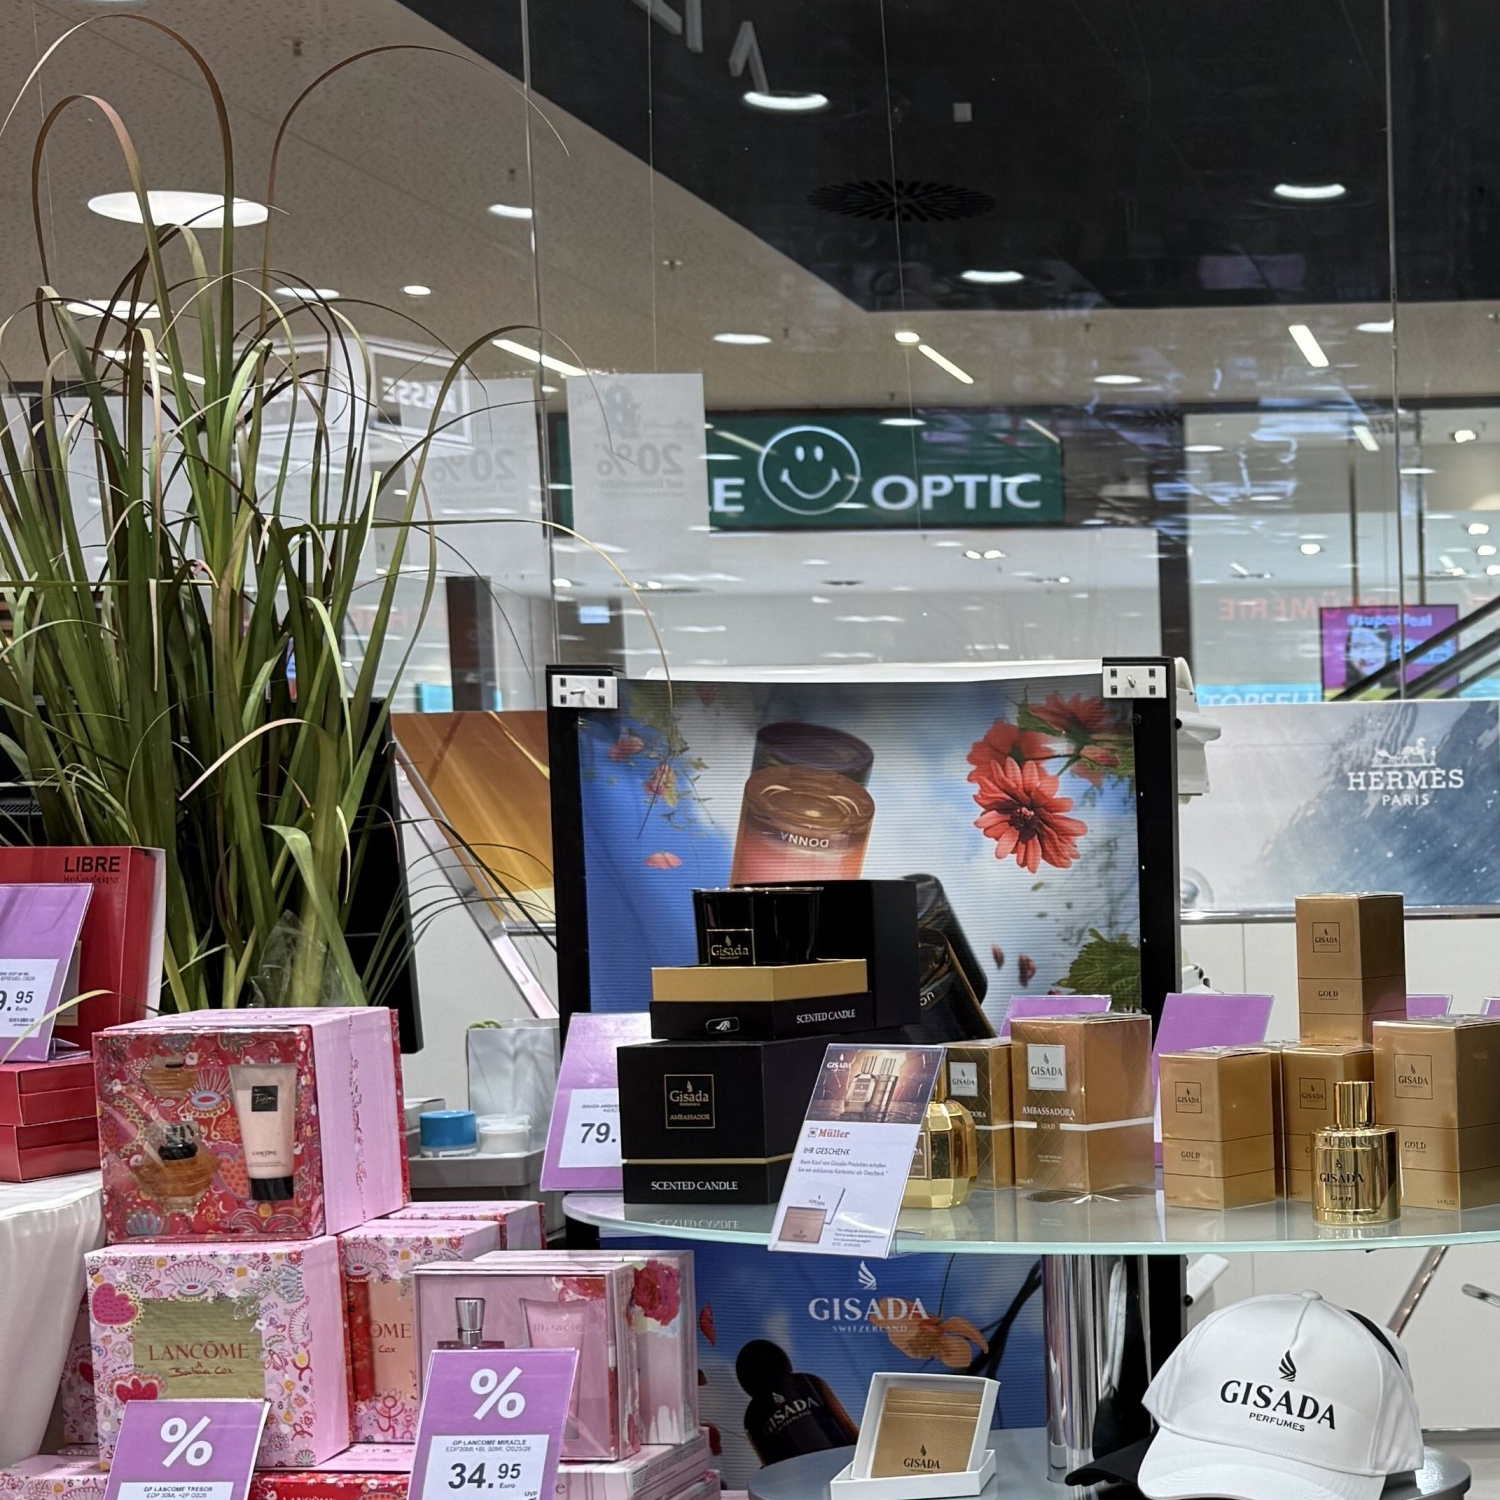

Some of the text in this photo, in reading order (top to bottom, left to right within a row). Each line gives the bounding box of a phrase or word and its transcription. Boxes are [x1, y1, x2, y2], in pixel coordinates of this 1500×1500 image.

[871, 473, 1042, 511] OPTIC
[1346, 768, 1465, 792] HERMÈS
[1382, 793, 1430, 807] PARIS
[780, 831, 830, 848] DONNA
[63, 855, 122, 873] LIBRE
[1313, 935, 1339, 944] GISADA
[710, 945, 749, 957] Gisada
[1318, 990, 1339, 998] GOLD
[796, 1009, 857, 1025] SCENTED CANDLE
[1030, 1065, 1064, 1078] GISADA
[951, 1077, 976, 1087] GISADA
[1398, 1075, 1429, 1086] GISADA
[669, 1089, 710, 1103] Gisada
[1301, 1092, 1325, 1100] GISADA
[669, 1113, 711, 1121] AMBASSADOR
[1021, 1105, 1076, 1118] AMBASSADORA
[818, 1128, 850, 1139] Müller
[803, 1147, 851, 1156] IHR GESCHENK
[1404, 1140, 1427, 1150] GOLD
[1180, 1151, 1201, 1159] GOLD
[1319, 1172, 1365, 1184] GISADA
[651, 1181, 739, 1191] SCENTED CANDLE
[808, 1297, 931, 1322] GISADA
[832, 1325, 908, 1333] SWITZERLAND
[149, 1342, 250, 1361] LANCÔME
[469, 1366, 526, 1421] %
[1220, 1379, 1336, 1431] GISADA
[1249, 1412, 1306, 1432] PERFUMES
[160, 1415, 213, 1468] %
[903, 1457, 941, 1470] GISADA
